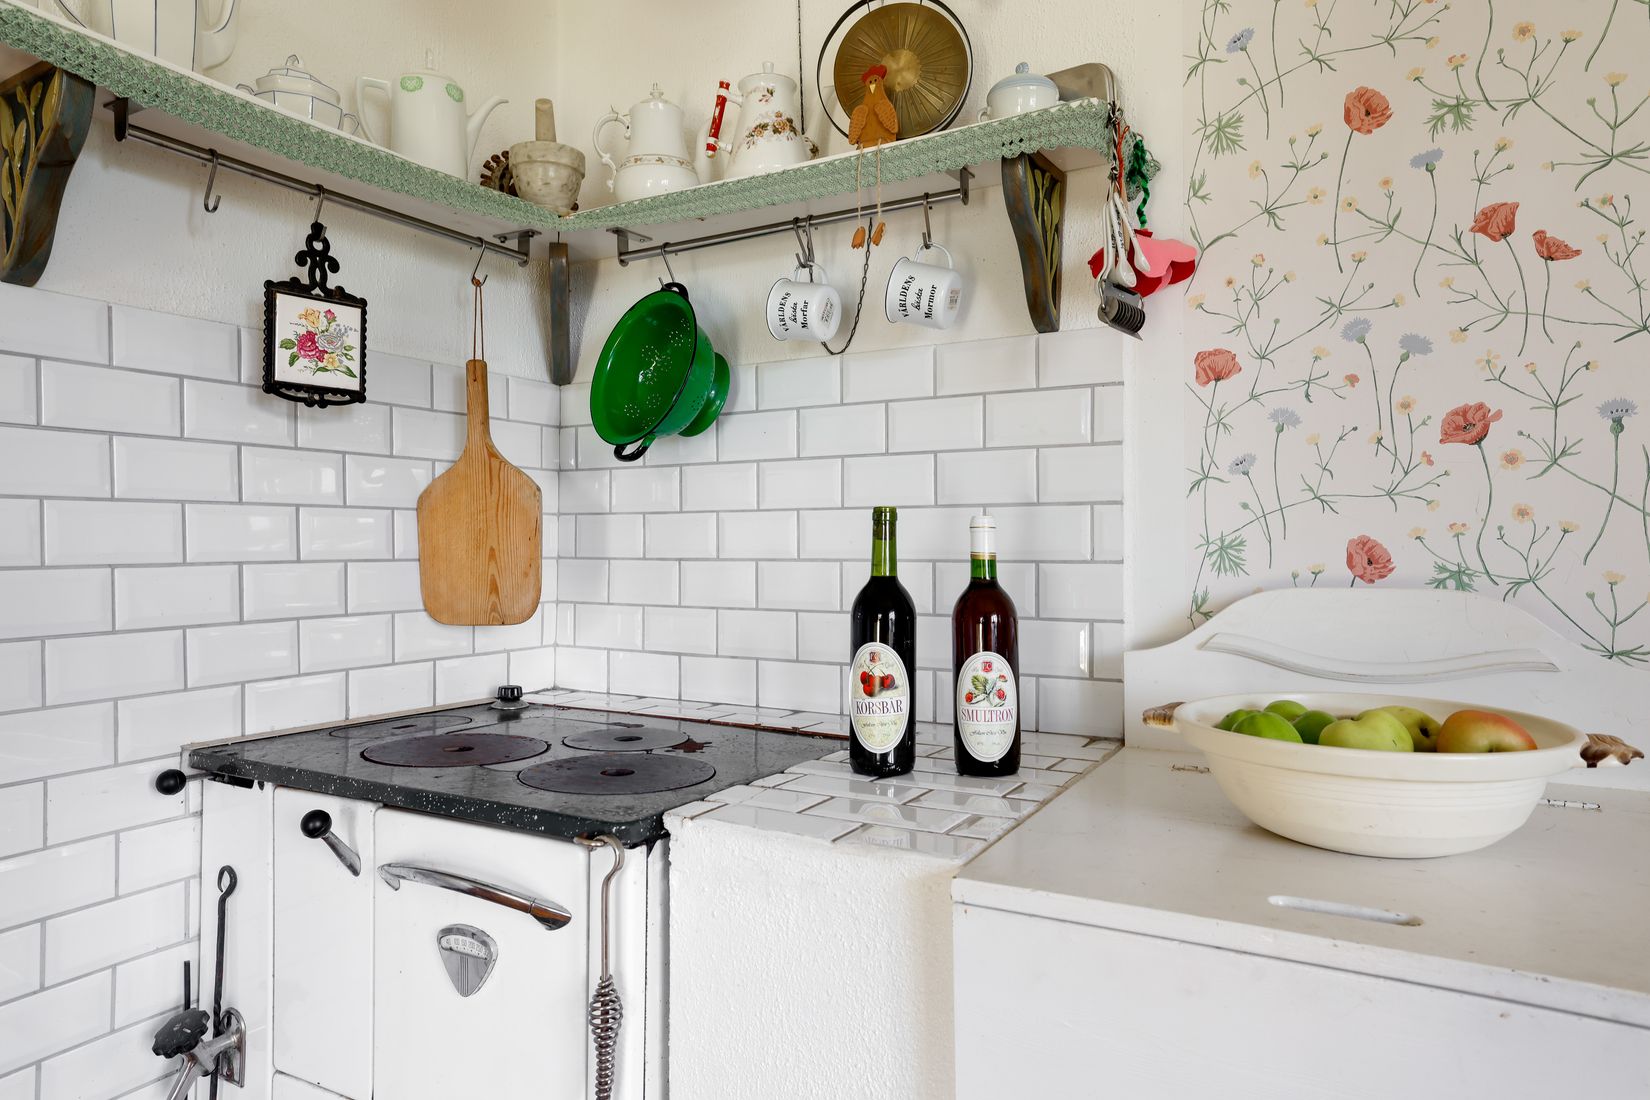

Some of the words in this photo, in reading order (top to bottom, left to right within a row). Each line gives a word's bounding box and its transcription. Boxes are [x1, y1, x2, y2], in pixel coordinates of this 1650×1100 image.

[898, 275, 916, 318] VÄRLDENS
[924, 284, 938, 320] Mormor
[799, 299, 809, 329] Morfar
[855, 698, 904, 716] KÖRSBÄR
[961, 708, 1014, 723] SMULTRON
